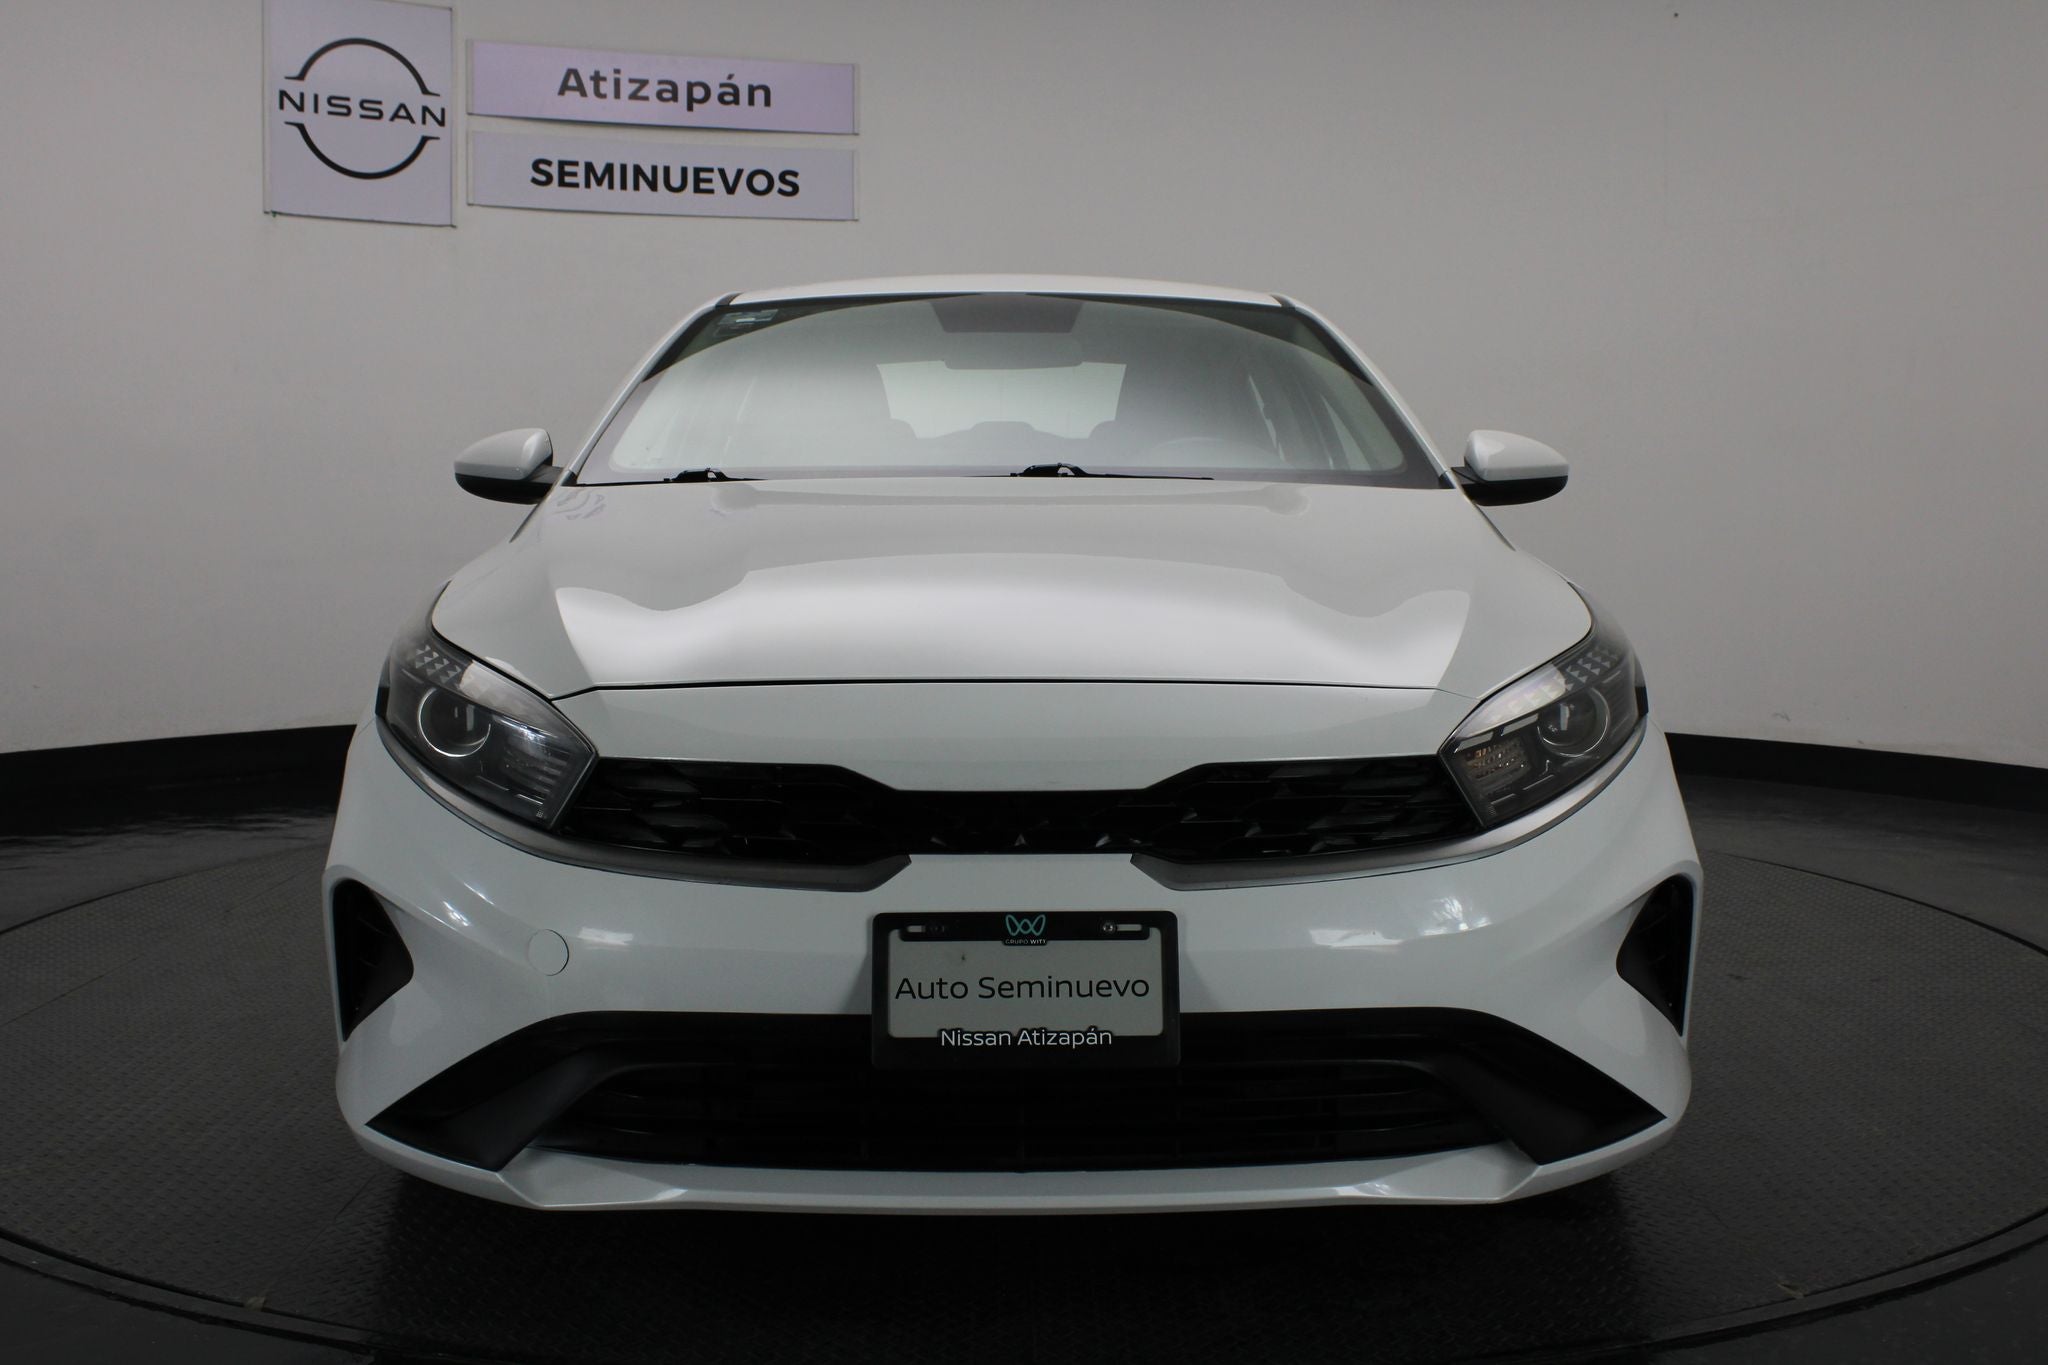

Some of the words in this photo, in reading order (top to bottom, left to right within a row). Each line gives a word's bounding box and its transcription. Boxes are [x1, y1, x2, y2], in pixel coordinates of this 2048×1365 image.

[280, 90, 446, 127] NISSAN
[558, 68, 773, 112] Atizapán
[531, 158, 800, 197] SEMINUEVOS
[895, 977, 968, 1000] Auto
[978, 975, 1150, 999] Seminuevo
[941, 1030, 1011, 1046] Nissan
[1017, 1027, 1112, 1049] Atizapán
